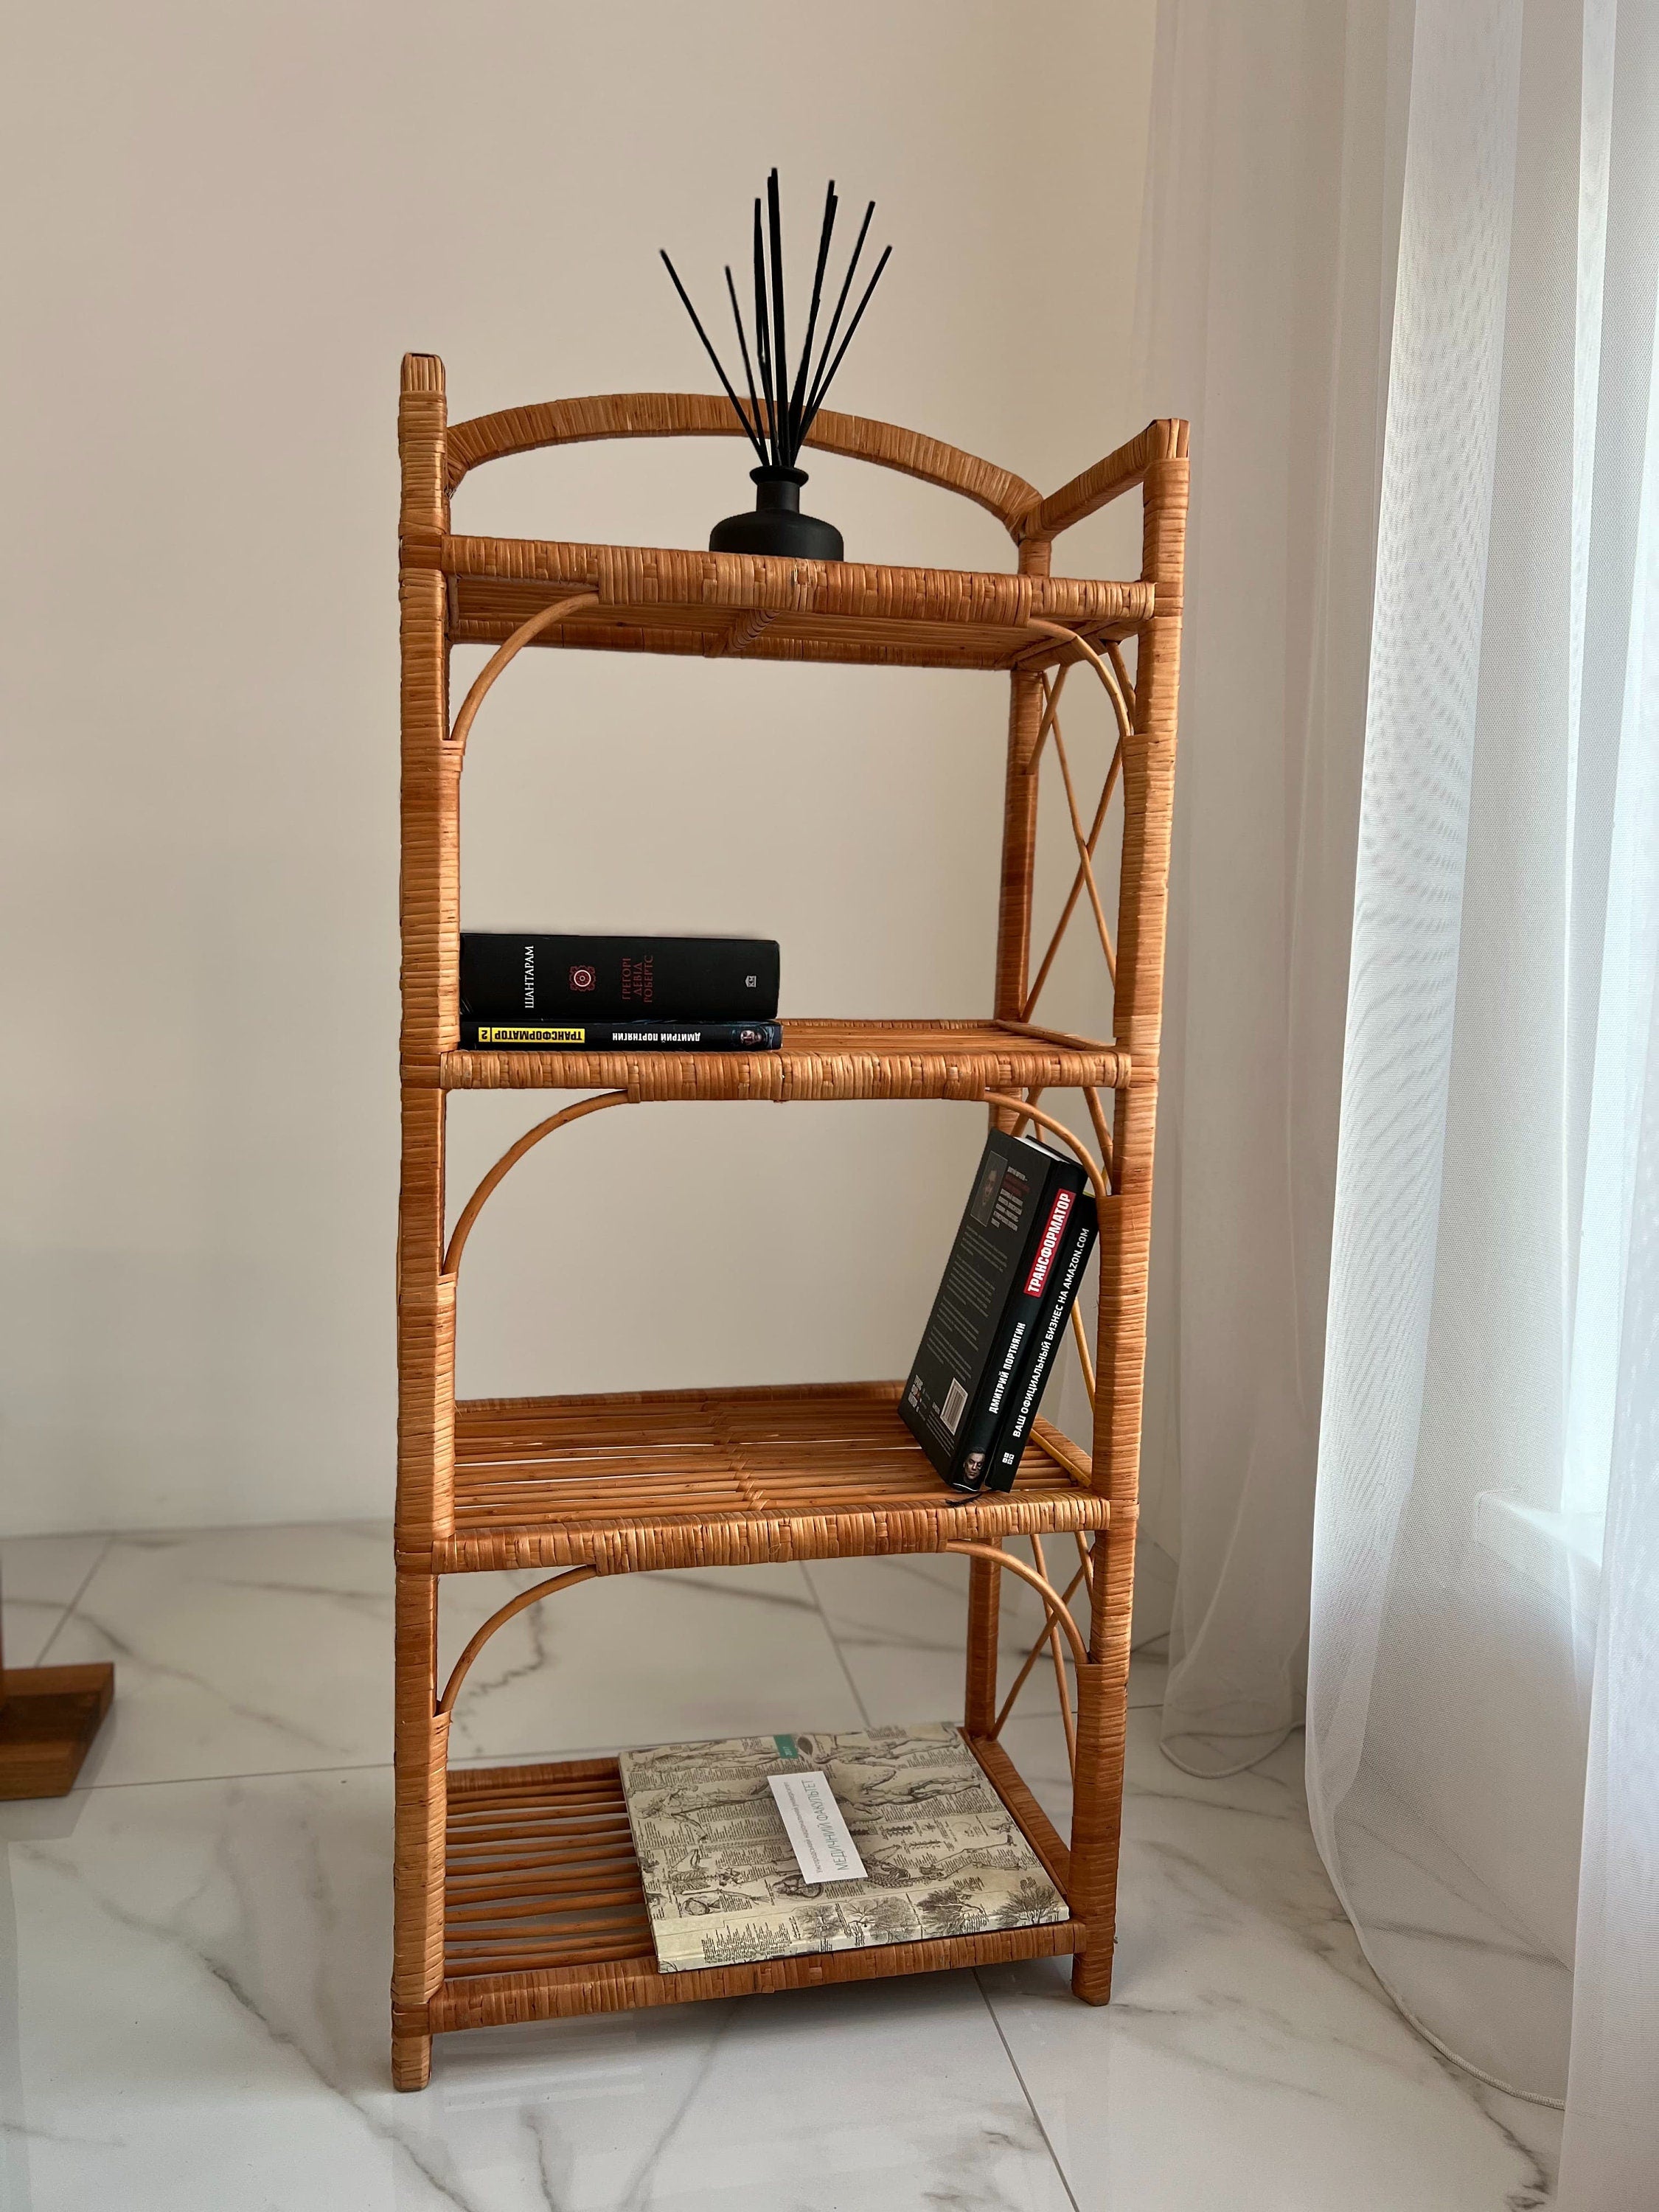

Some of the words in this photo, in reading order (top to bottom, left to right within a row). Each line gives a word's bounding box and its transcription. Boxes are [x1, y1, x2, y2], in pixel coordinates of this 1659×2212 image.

[524, 945, 534, 1008] ШАНТАРАМ
[622, 956, 632, 1000] ГРЕГОРІ
[633, 962, 643, 995] ДЕВІД
[643, 955, 654, 1003] РОБЕРТС
[481, 1030, 488, 1040] 2
[495, 1030, 582, 1041] ТРАНСФОРМАТОР
[612, 1032, 658, 1041] ПОРТНЯГИН
[661, 1032, 700, 1043] ДМИТРИЙ
[1028, 1193, 1071, 1293] ТРАНСФОРМАТОР
[1013, 1415, 1026, 1438] ВАШ
[1021, 1341, 1051, 1414] ОФИЦИАЛЬНЫЙ
[1046, 1304, 1064, 1340] БИЗНЕС
[1058, 1290, 1069, 1304] НА
[1065, 1228, 1089, 1289] AMAZON.COM
[989, 1371, 1009, 1414] ДМИТРИЙ
[1004, 1322, 1026, 1370] ПОРТНЯГИН
[801, 1779, 830, 1821] ФАКУЛЬТЕТ
[818, 1823, 849, 1871] МЕДИЧНИЙ
